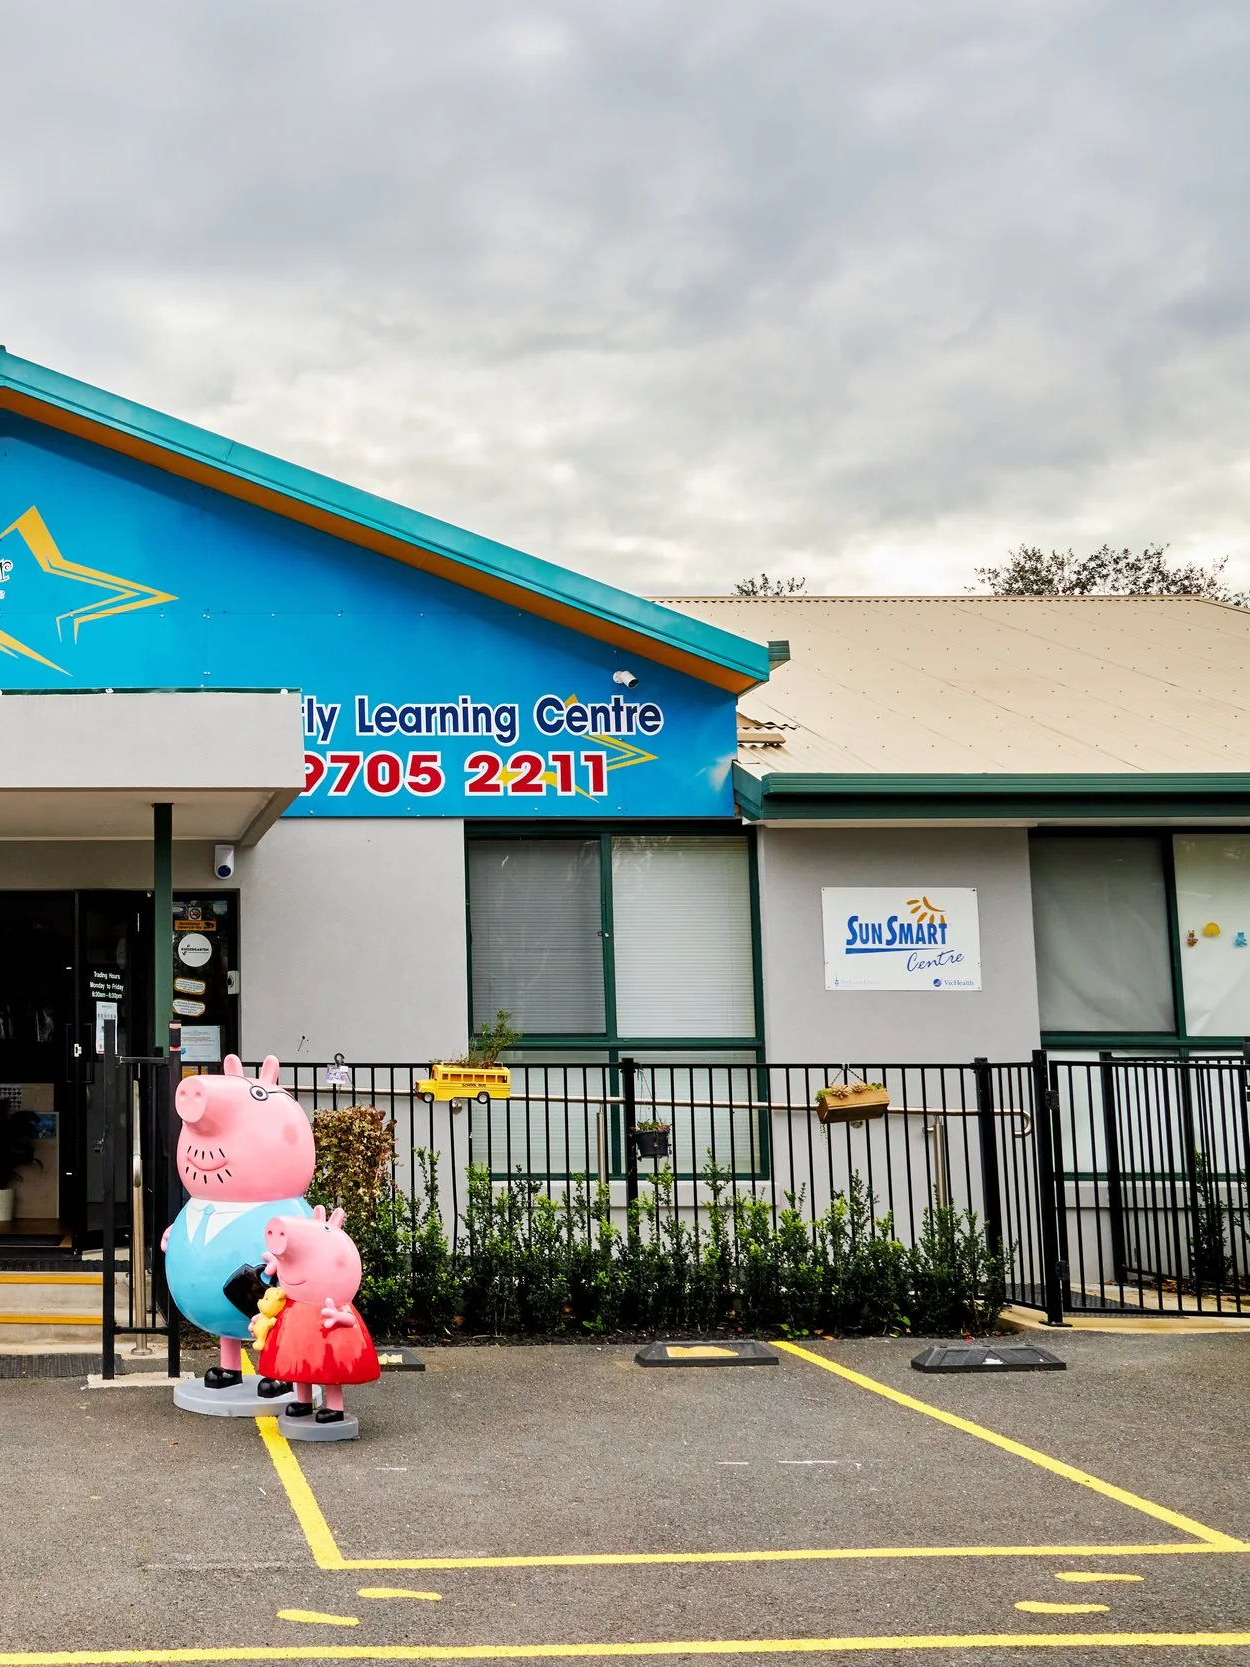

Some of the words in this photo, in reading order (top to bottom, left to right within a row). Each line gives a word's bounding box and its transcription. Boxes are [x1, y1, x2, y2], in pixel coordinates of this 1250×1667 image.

[355, 695, 519, 747] Learning
[533, 694, 663, 736] Centre
[464, 751, 608, 796] 2211
[907, 949, 965, 972] Centre
[90, 981, 105, 990] Monday
[111, 983, 124, 991] Friday
[93, 970, 108, 980] Trading
[109, 972, 120, 980] Hours
